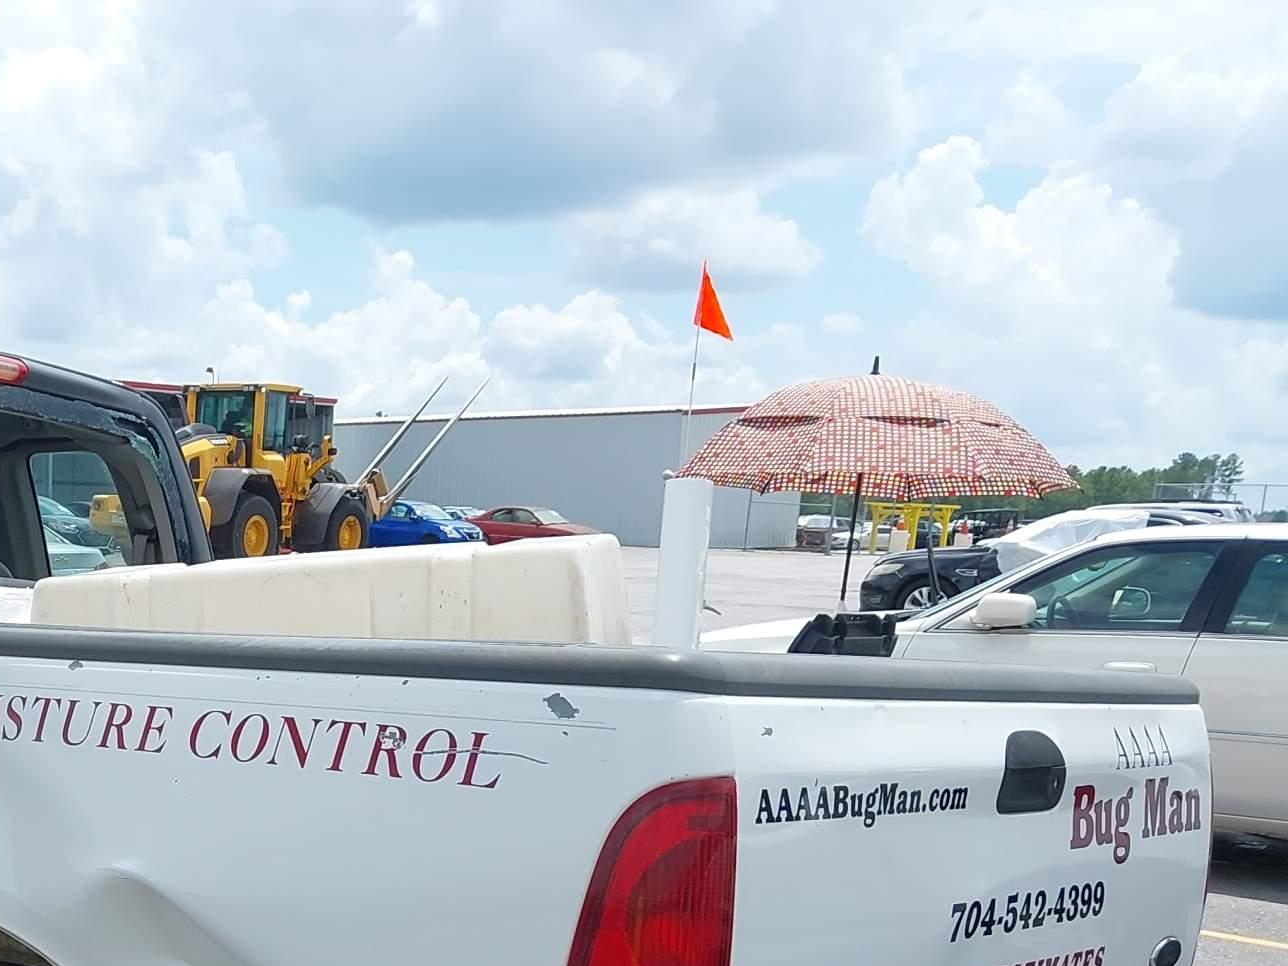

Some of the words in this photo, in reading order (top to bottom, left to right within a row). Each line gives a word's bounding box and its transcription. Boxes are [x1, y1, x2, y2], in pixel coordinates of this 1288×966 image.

[188, 710, 502, 790] CONTROL
[1113, 724, 1173, 770] AAAA
[755, 782, 969, 829] AAAABugMan.com
[1070, 784, 1134, 865] Bug
[1141, 775, 1202, 840] Man
[949, 880, 1106, 943] 704-542-4399
